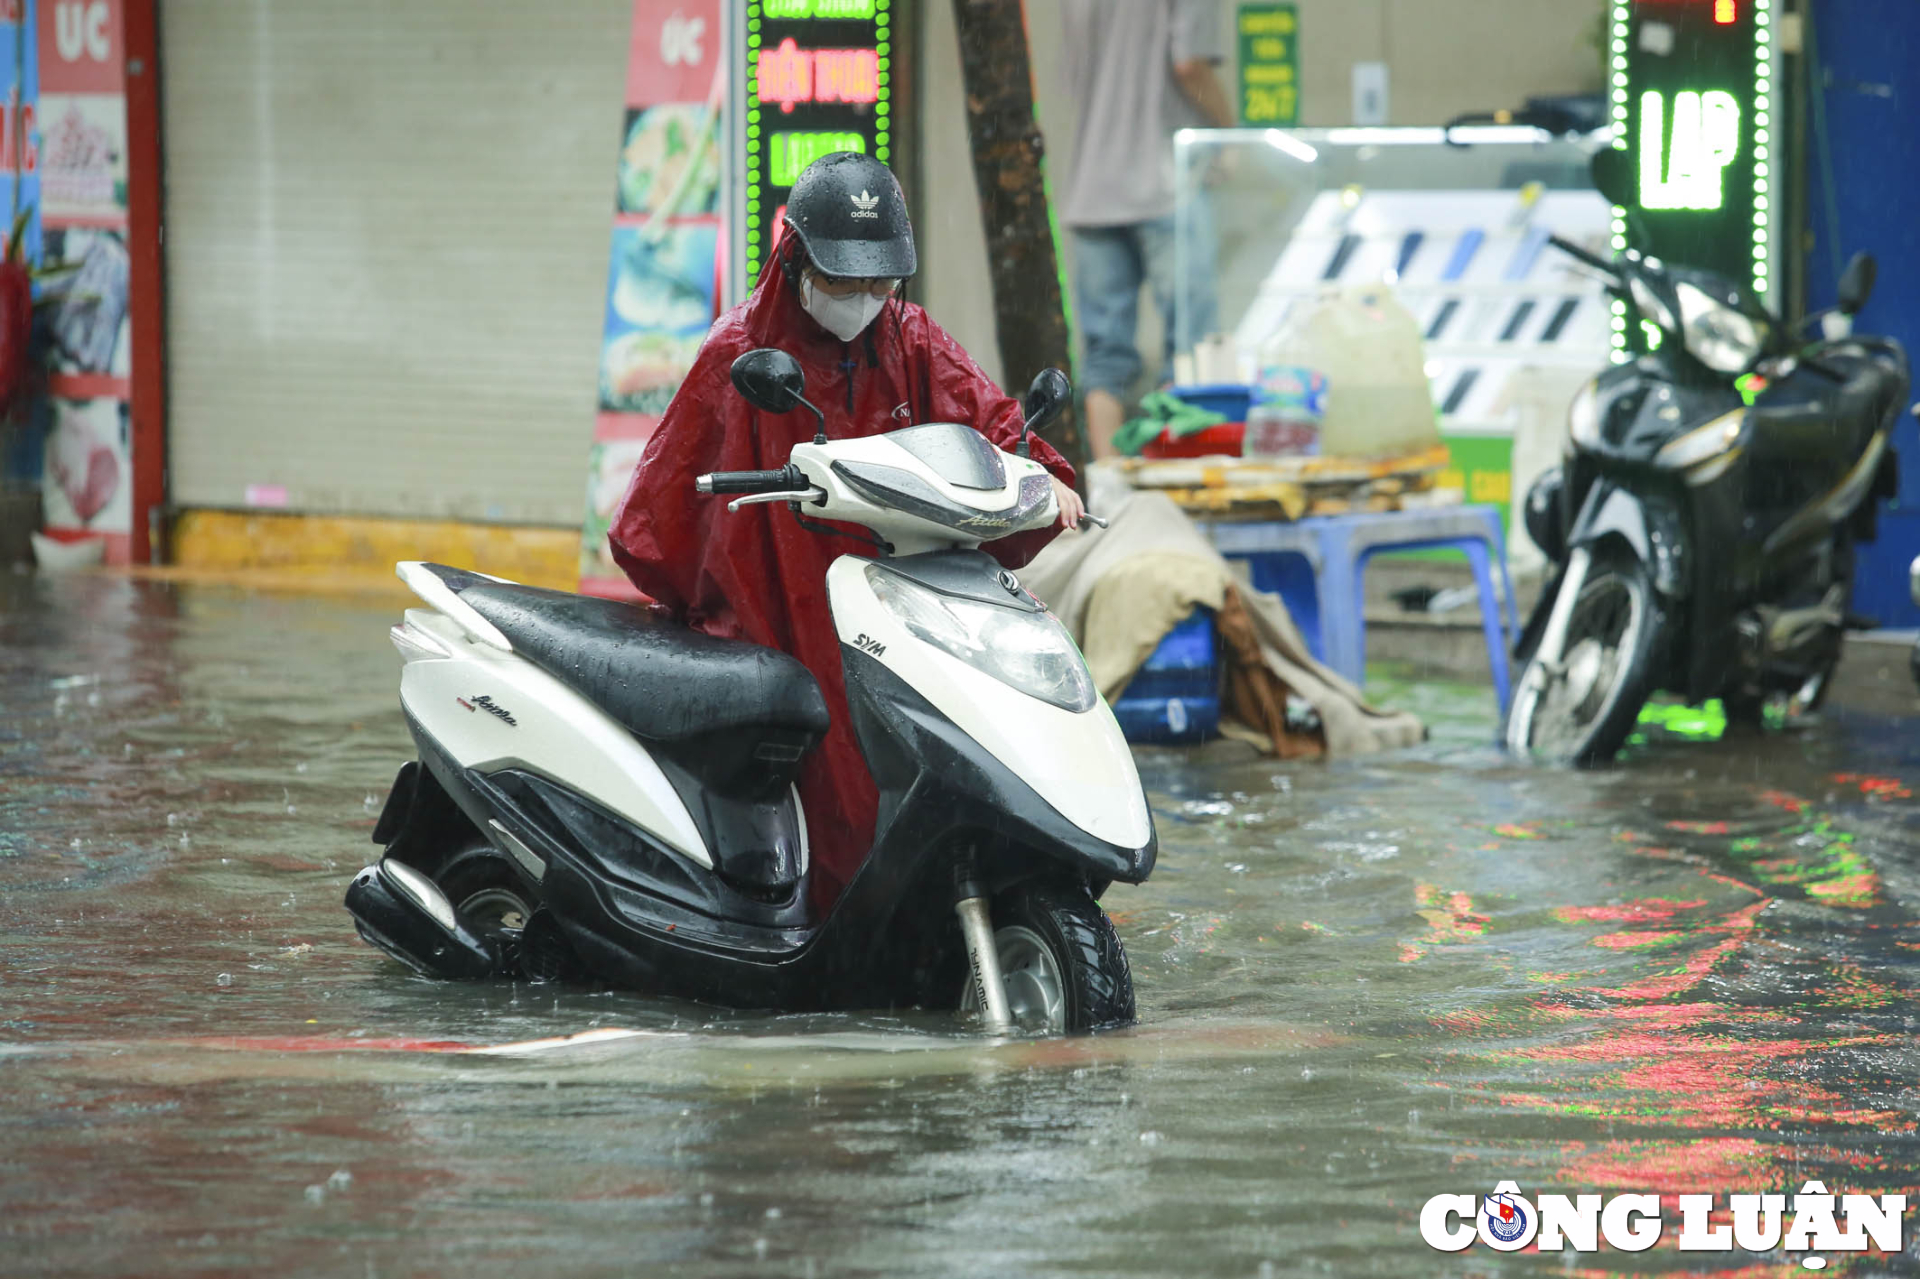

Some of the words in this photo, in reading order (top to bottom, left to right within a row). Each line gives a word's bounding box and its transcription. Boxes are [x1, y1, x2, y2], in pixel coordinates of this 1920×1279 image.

[1639, 90, 1741, 211] LAP
[850, 210, 879, 219] adidas
[852, 633, 887, 658] SYM
